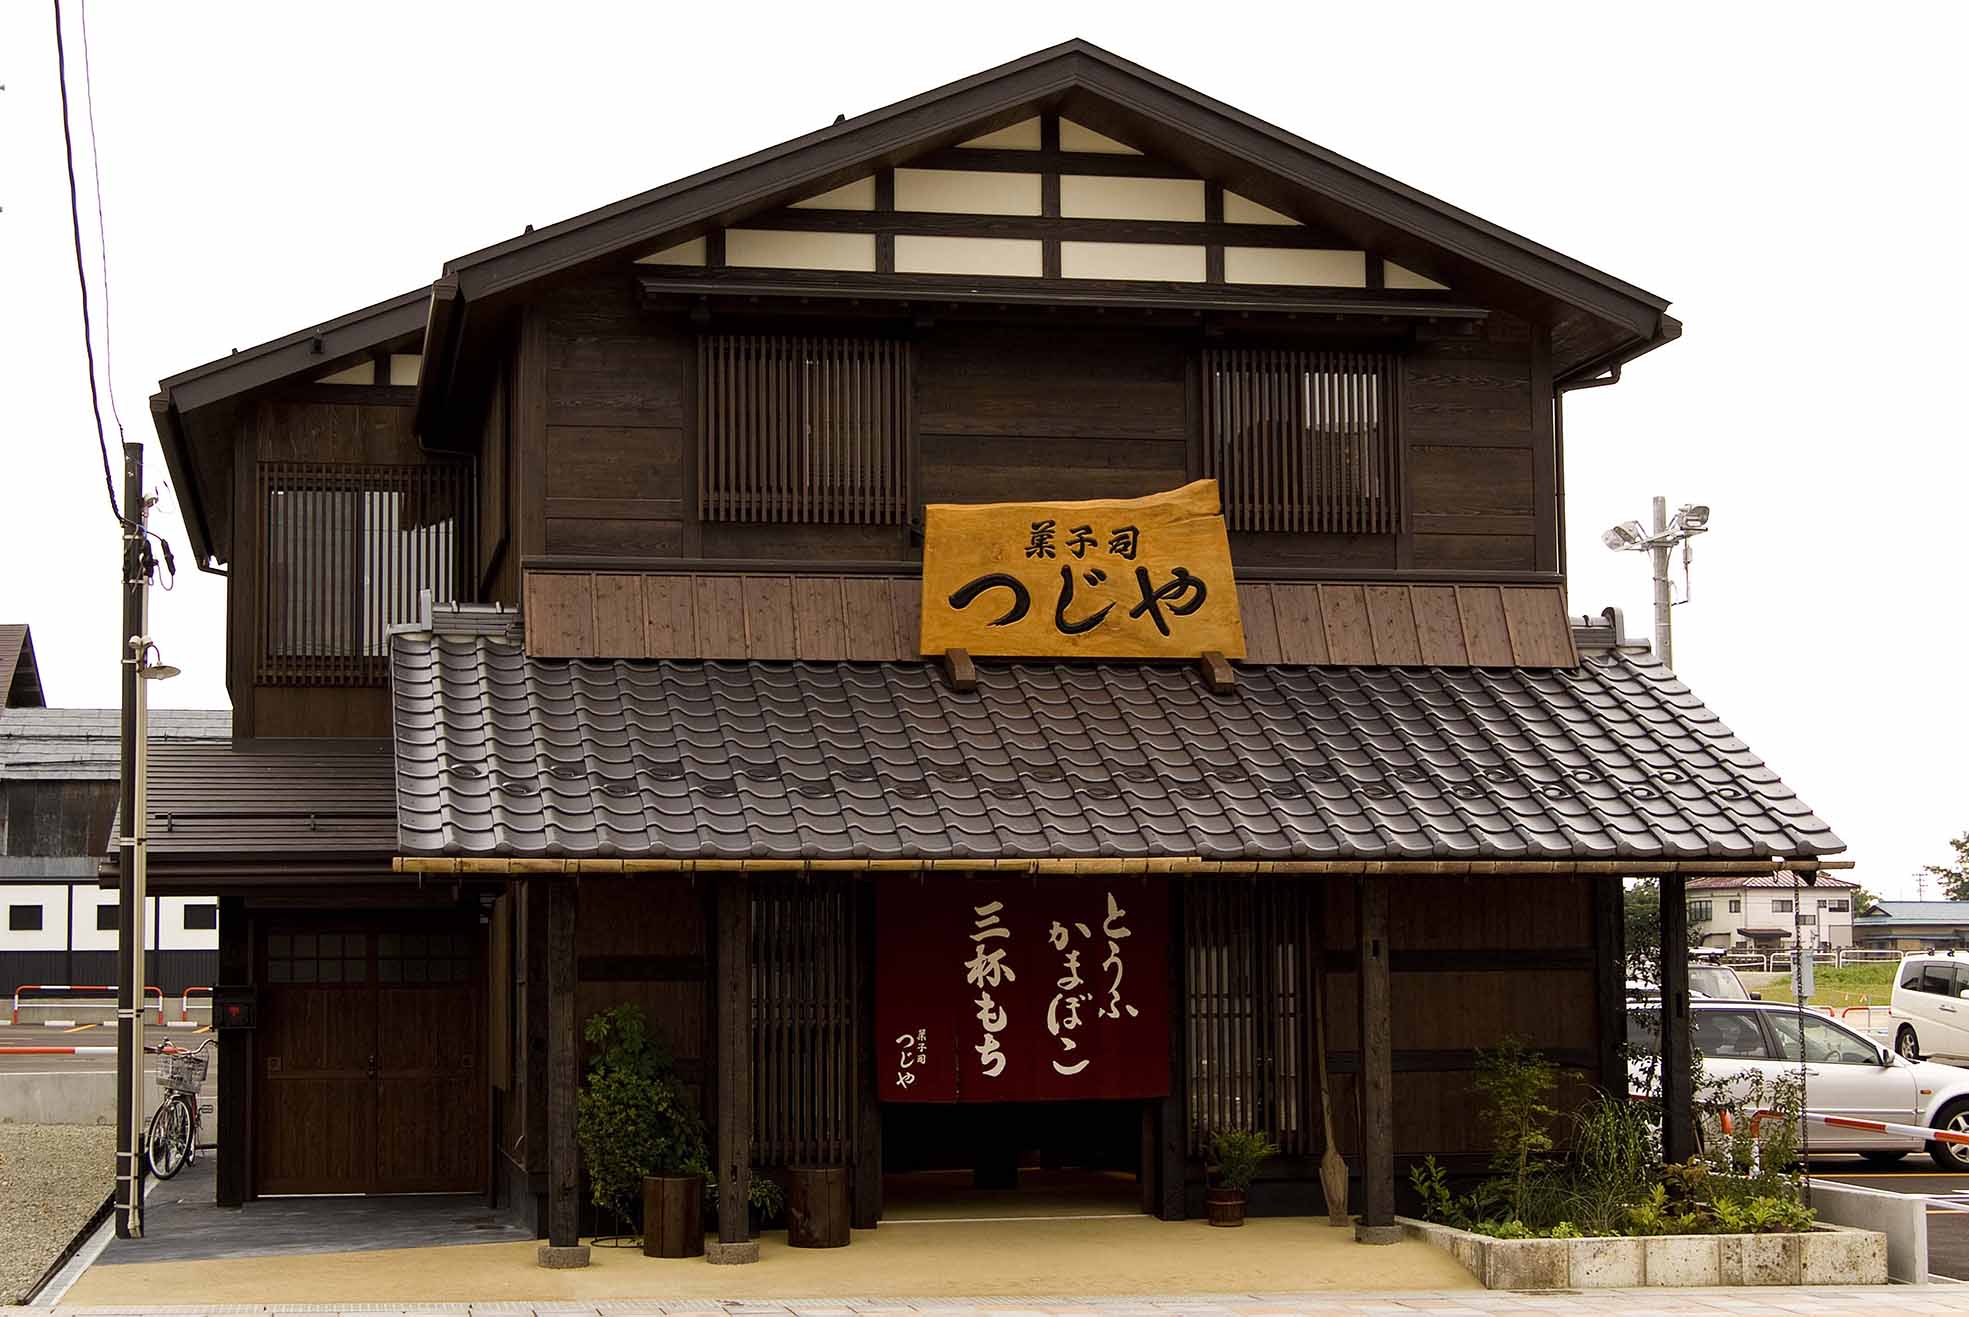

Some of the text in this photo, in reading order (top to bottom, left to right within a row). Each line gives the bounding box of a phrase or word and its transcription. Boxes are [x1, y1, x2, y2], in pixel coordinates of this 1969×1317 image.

[1024, 519, 1139, 560] 菓子司
[948, 564, 1207, 637] つじや
[964, 901, 1016, 1077] 三杯もち
[1099, 892, 1139, 1018] とうふ
[1047, 920, 1093, 1075] かまぼこ
[896, 1034, 915, 1088] つじや
[916, 1028, 927, 1065] 菓子司
